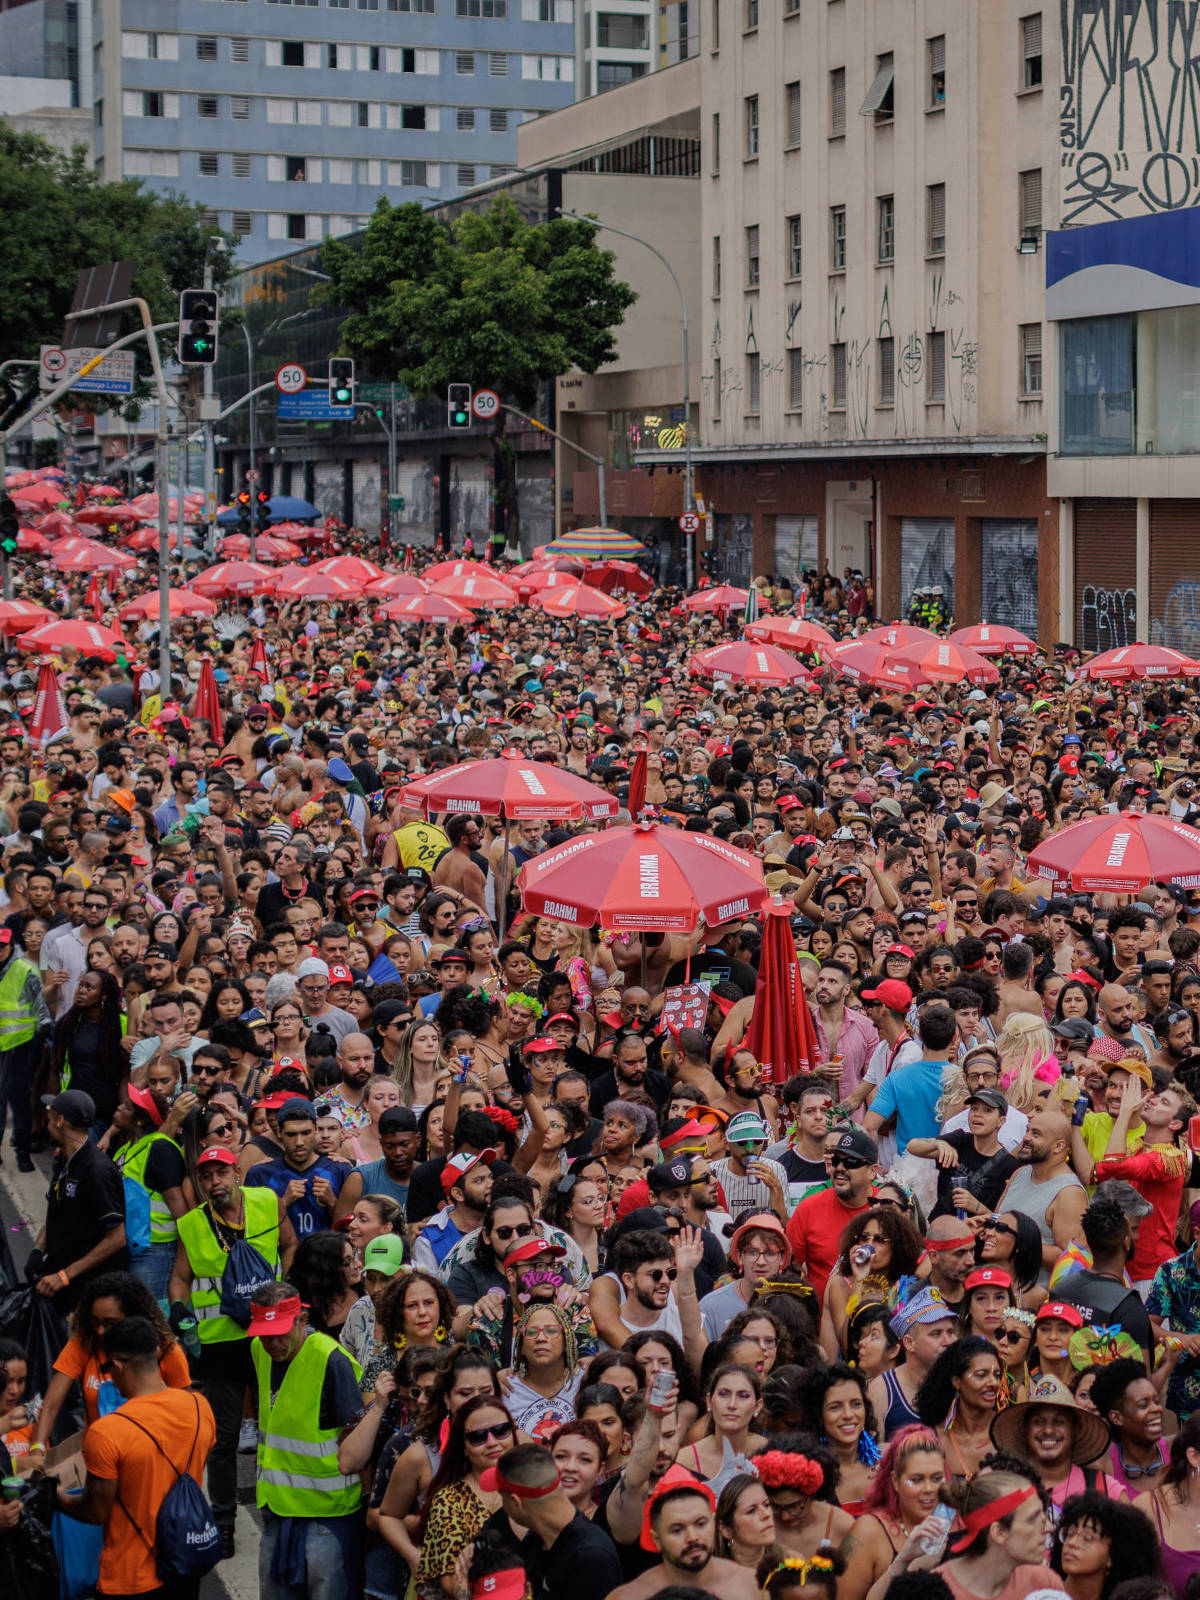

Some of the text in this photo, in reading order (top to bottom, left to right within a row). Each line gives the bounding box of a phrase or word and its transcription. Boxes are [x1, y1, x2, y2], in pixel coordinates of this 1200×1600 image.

[282, 371, 301, 384] 50
[477, 397, 496, 409] 50
[446, 799, 481, 813] BRAHMA
[538, 837, 595, 872] BRAHMA
[1106, 832, 1132, 867] BRAHMA
[639, 853, 660, 899] BRAHMA
[544, 900, 578, 922] BRAHMA
[717, 898, 750, 921] BRAHMA
[297, 1212, 313, 1233] 10
